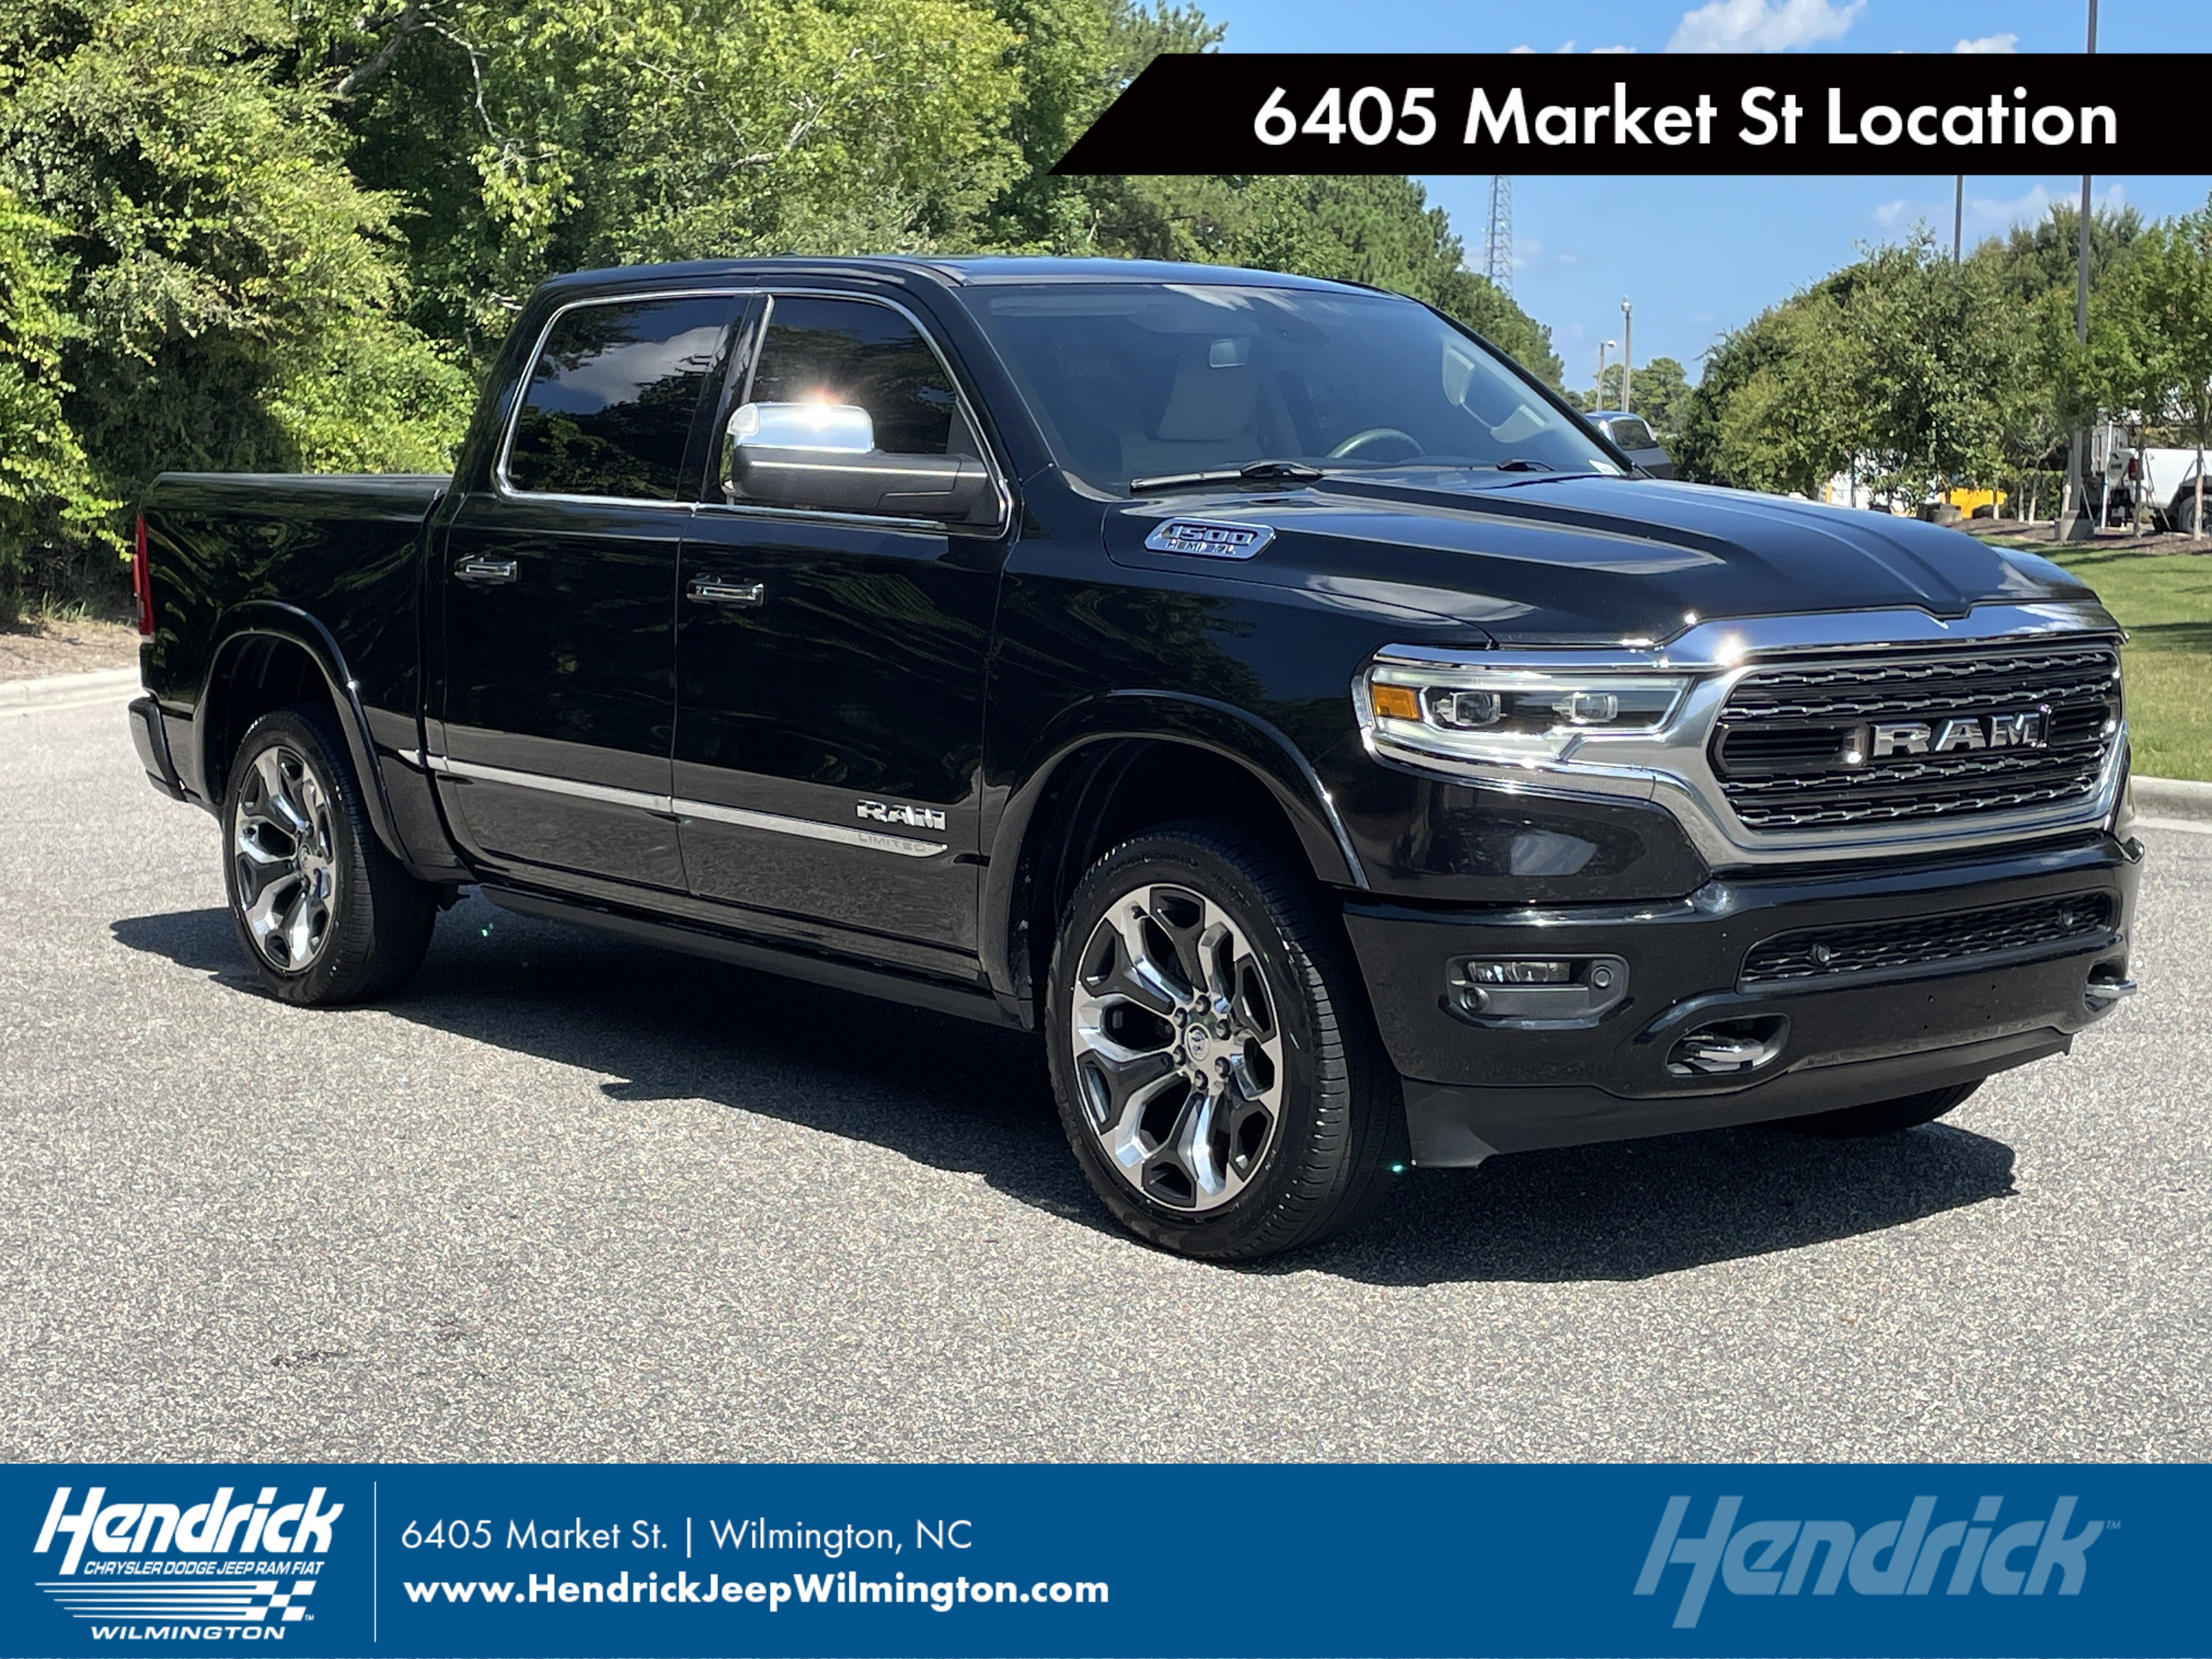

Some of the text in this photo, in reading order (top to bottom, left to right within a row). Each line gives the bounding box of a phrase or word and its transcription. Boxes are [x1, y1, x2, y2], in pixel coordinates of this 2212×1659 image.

[1167, 524, 1255, 545] 1500
[1869, 704, 2053, 757] RAM
[856, 799, 946, 831] RAM
[858, 833, 926, 851] LIMITED
